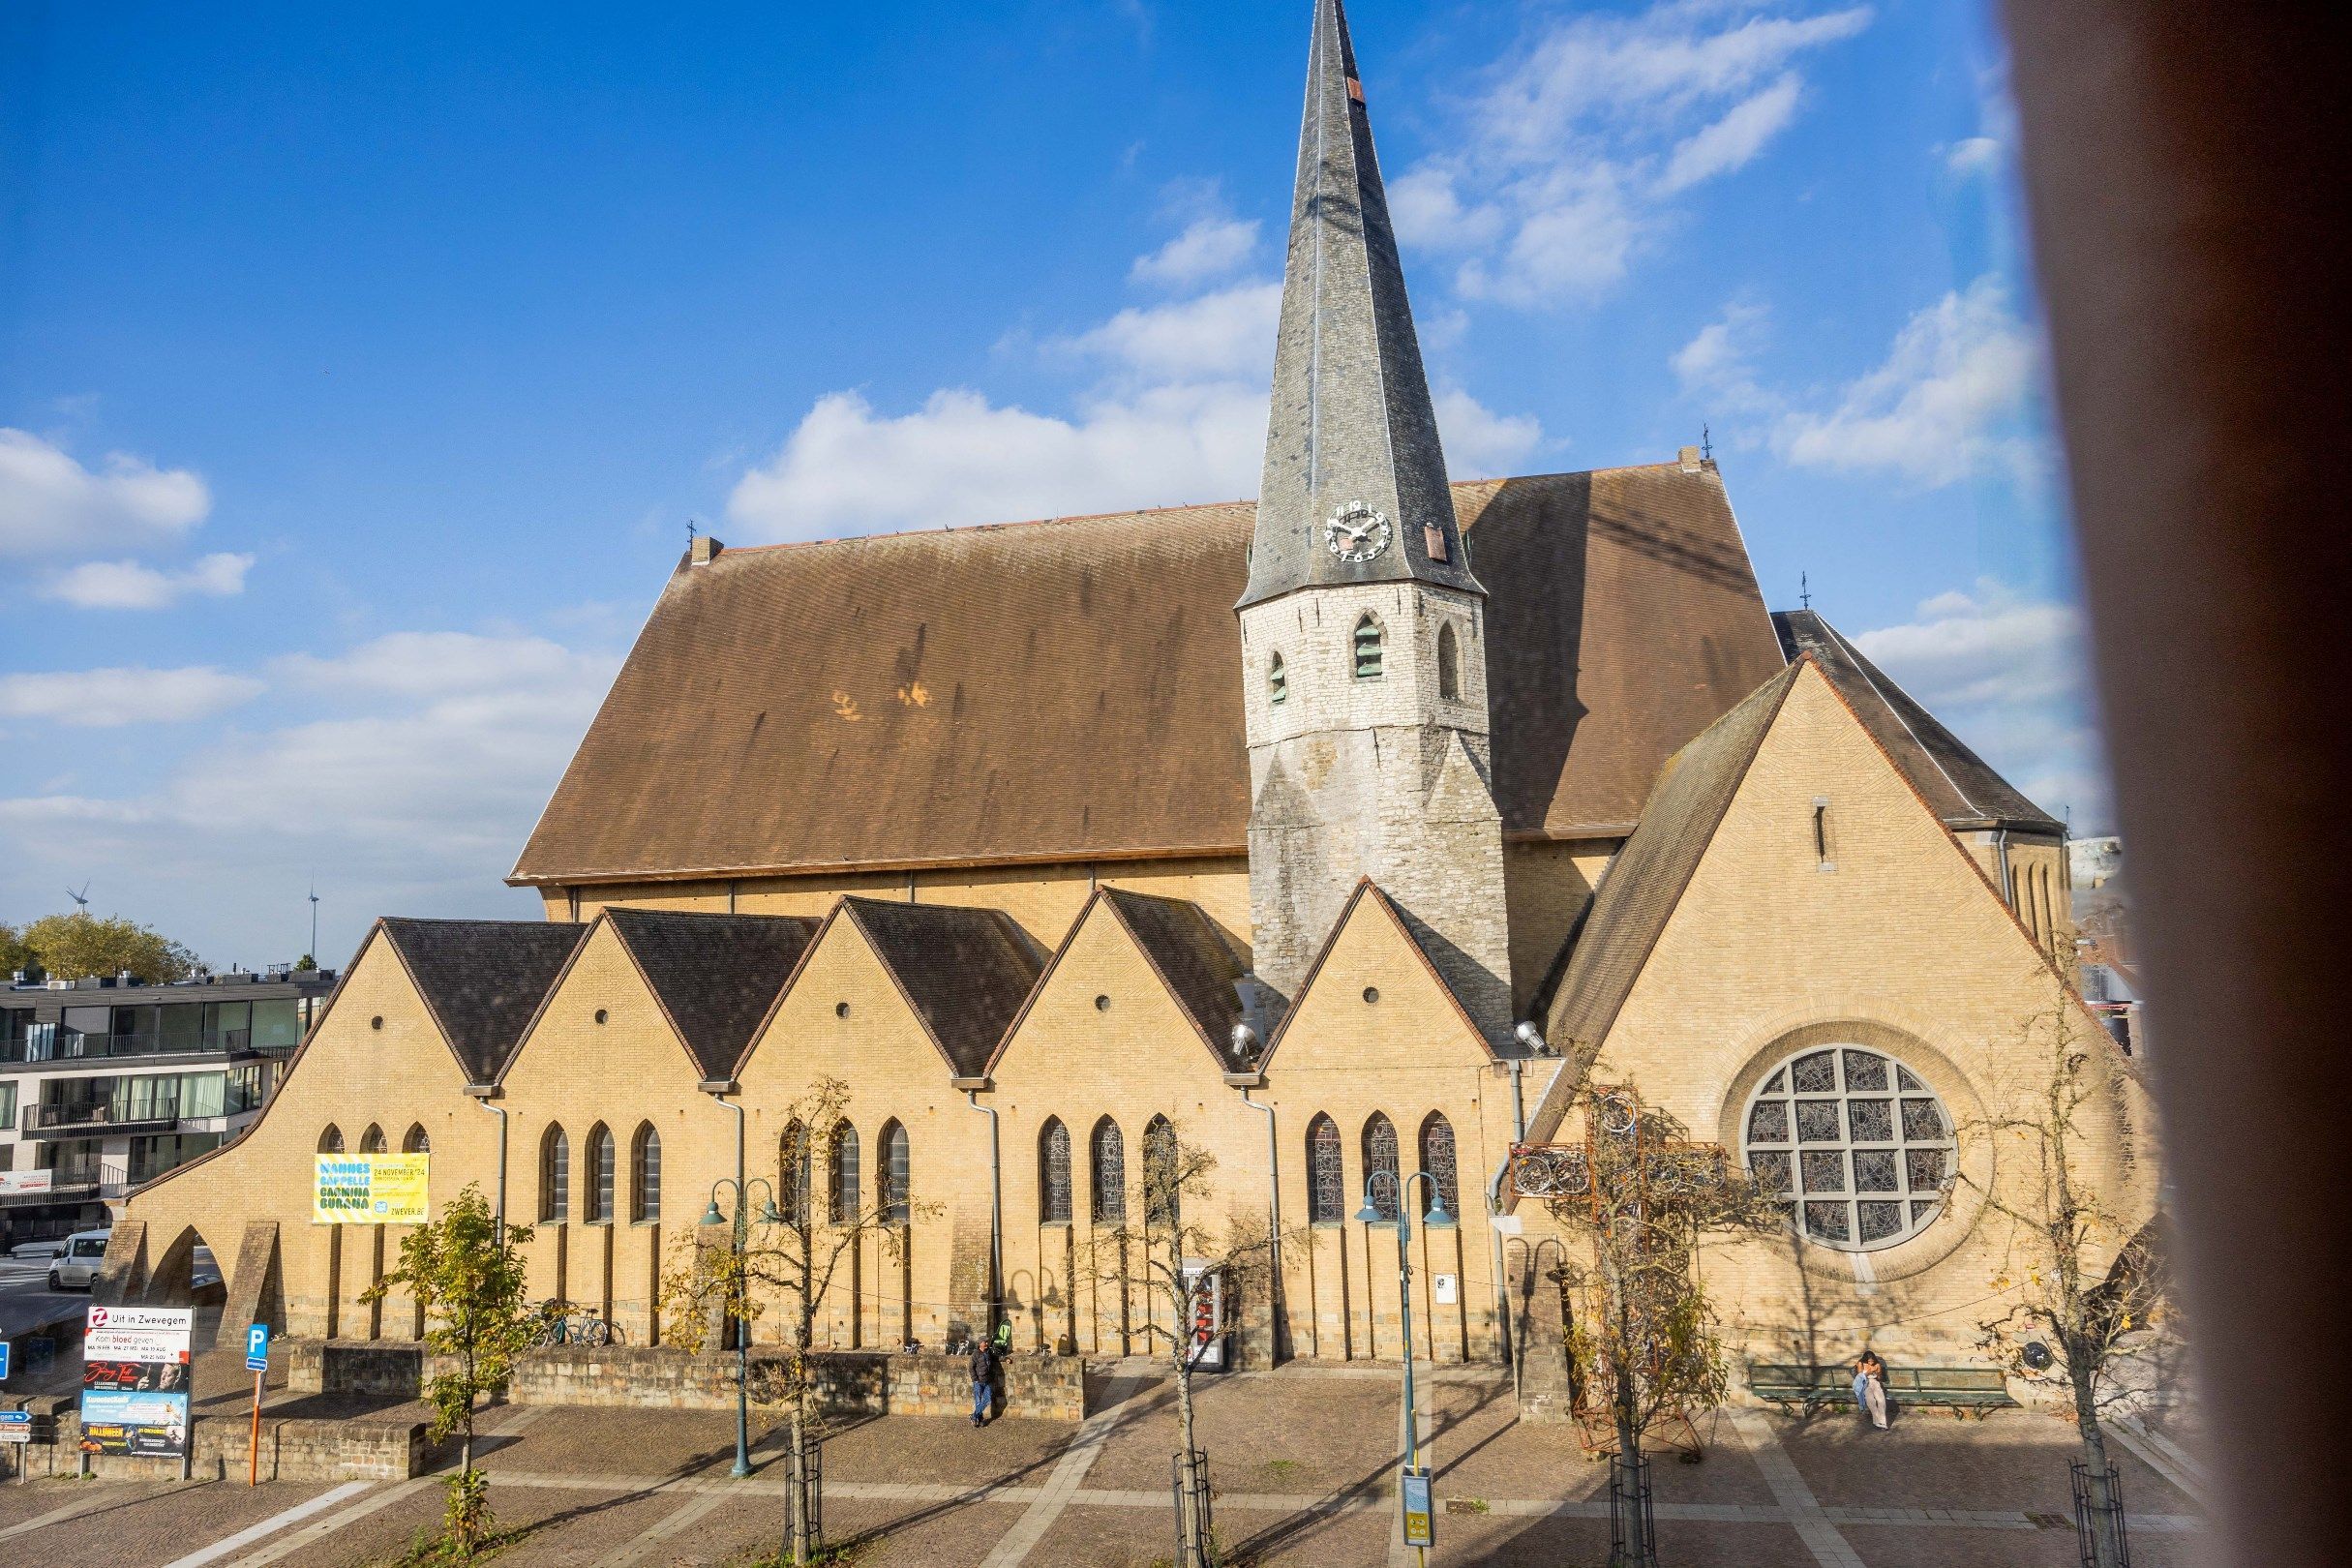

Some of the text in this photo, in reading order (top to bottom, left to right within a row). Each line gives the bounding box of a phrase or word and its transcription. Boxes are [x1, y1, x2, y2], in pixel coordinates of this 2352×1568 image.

[1337, 505, 1343, 516] 11
[1354, 552, 1363, 562] 6
[320, 1162, 370, 1174] WANNES
[374, 1168, 381, 1177] 24
[320, 1176, 370, 1186] CAPPELLE
[320, 1187, 370, 1197] CARMINA
[320, 1198, 369, 1209] BURANA
[391, 1207, 424, 1216] ZWEVER.BE
[112, 1314, 187, 1326] Uit in Zwevegem
[112, 1335, 133, 1343] bloed
[250, 1330, 264, 1353] P
[89, 1427, 124, 1437] HALLOWEEN
